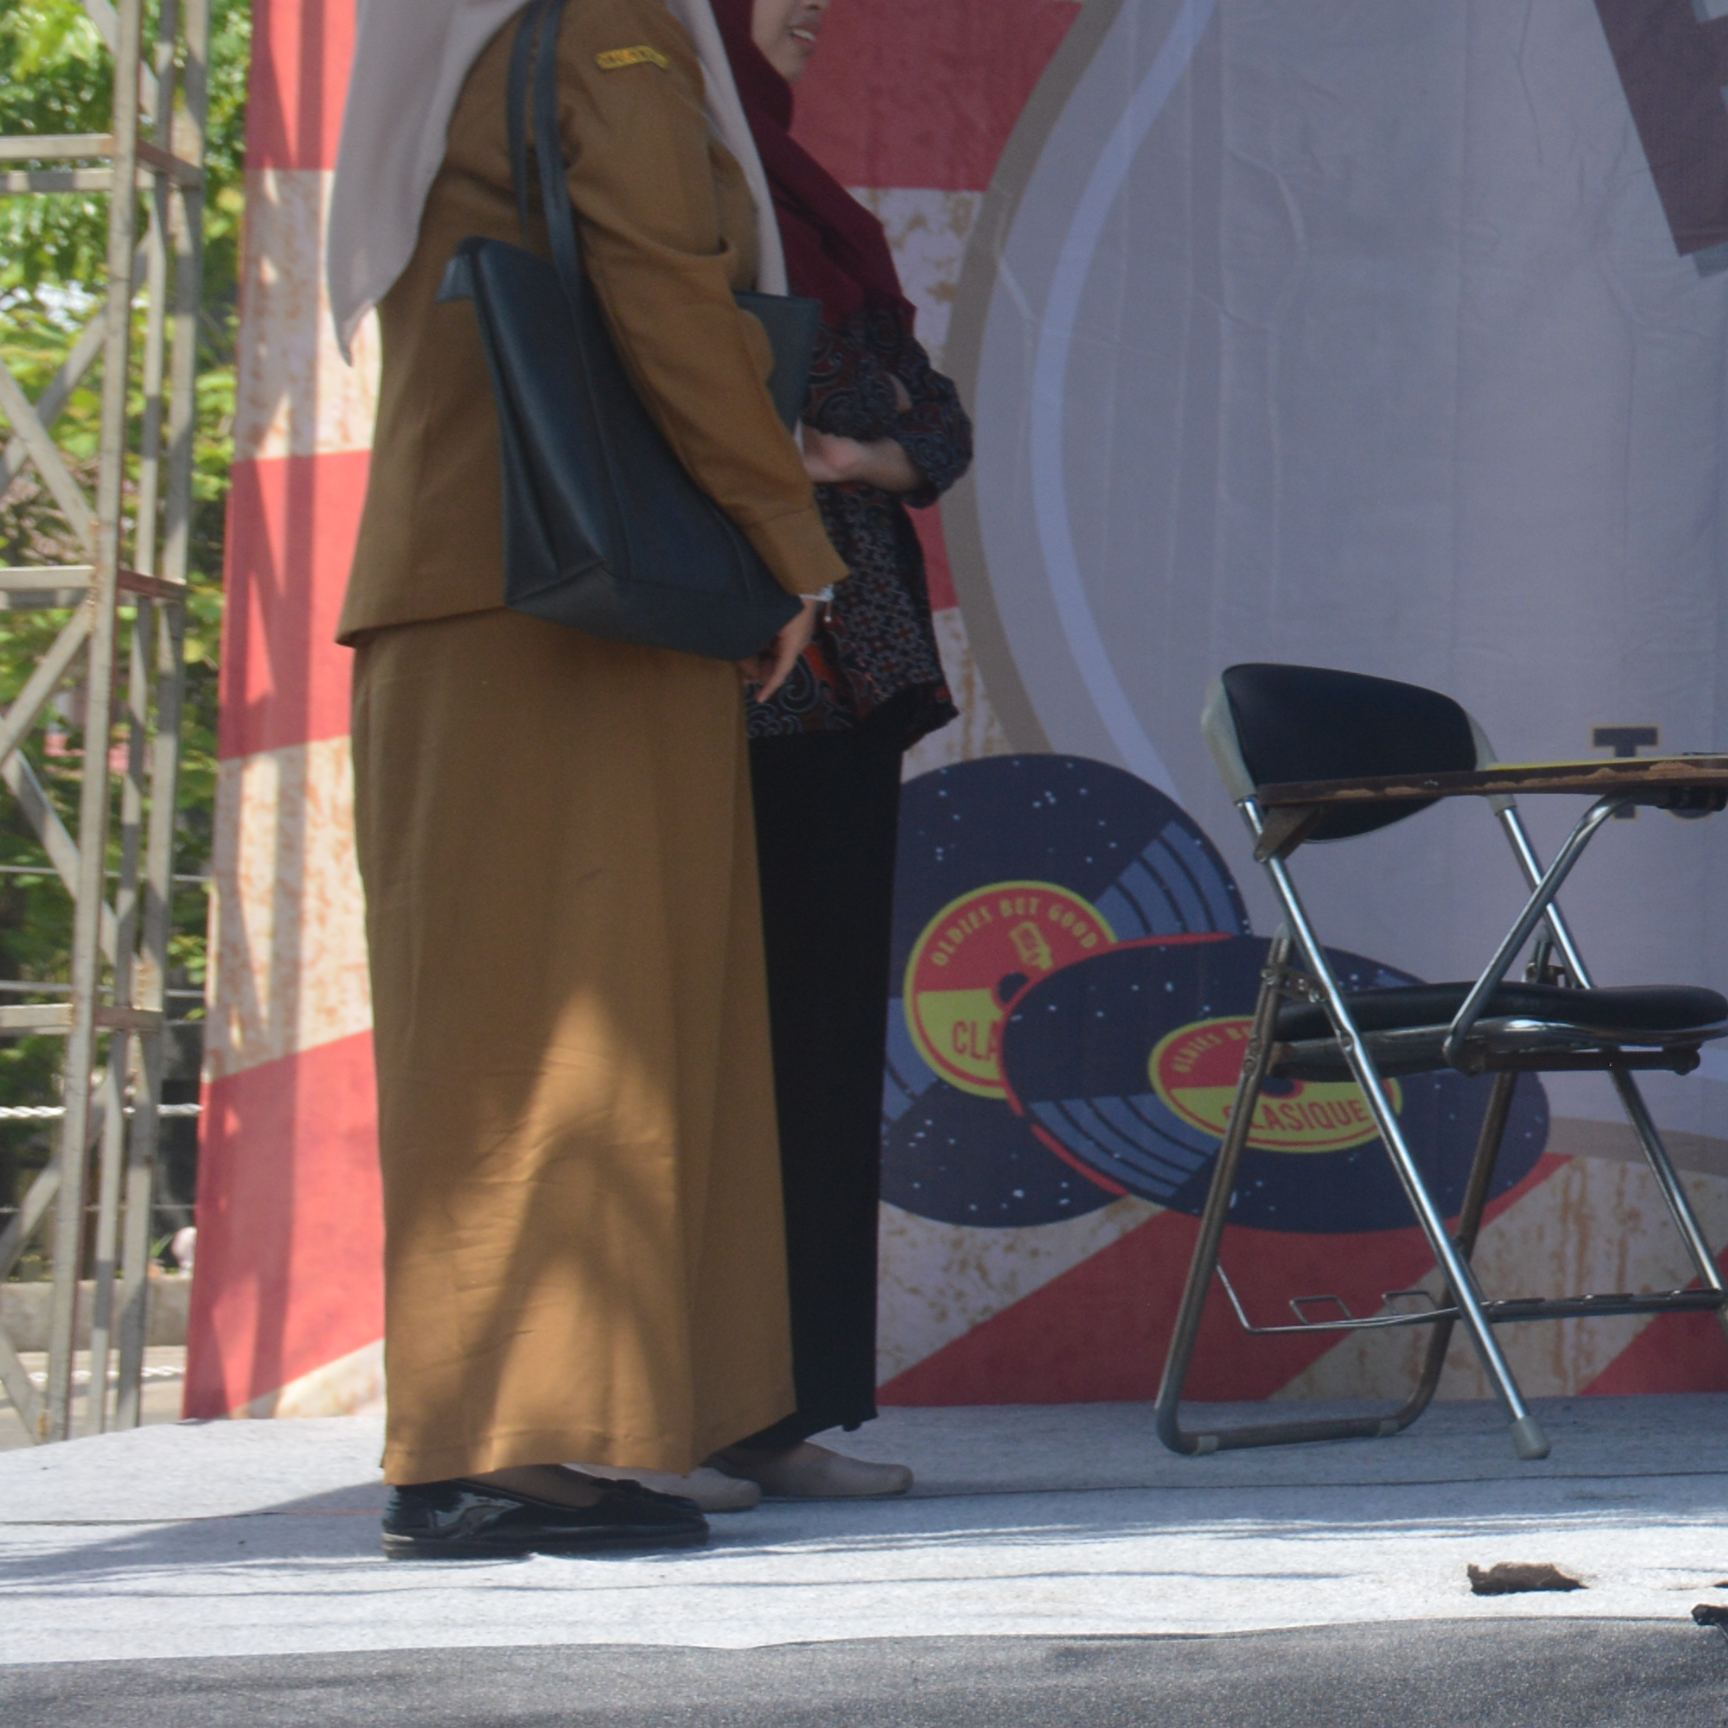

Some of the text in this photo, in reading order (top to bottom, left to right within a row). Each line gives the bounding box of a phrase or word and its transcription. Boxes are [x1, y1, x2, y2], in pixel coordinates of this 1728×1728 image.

[931, 896, 1098, 966] OLDIES BUT GOOD
[1221, 1098, 1370, 1133] ASIQUE
